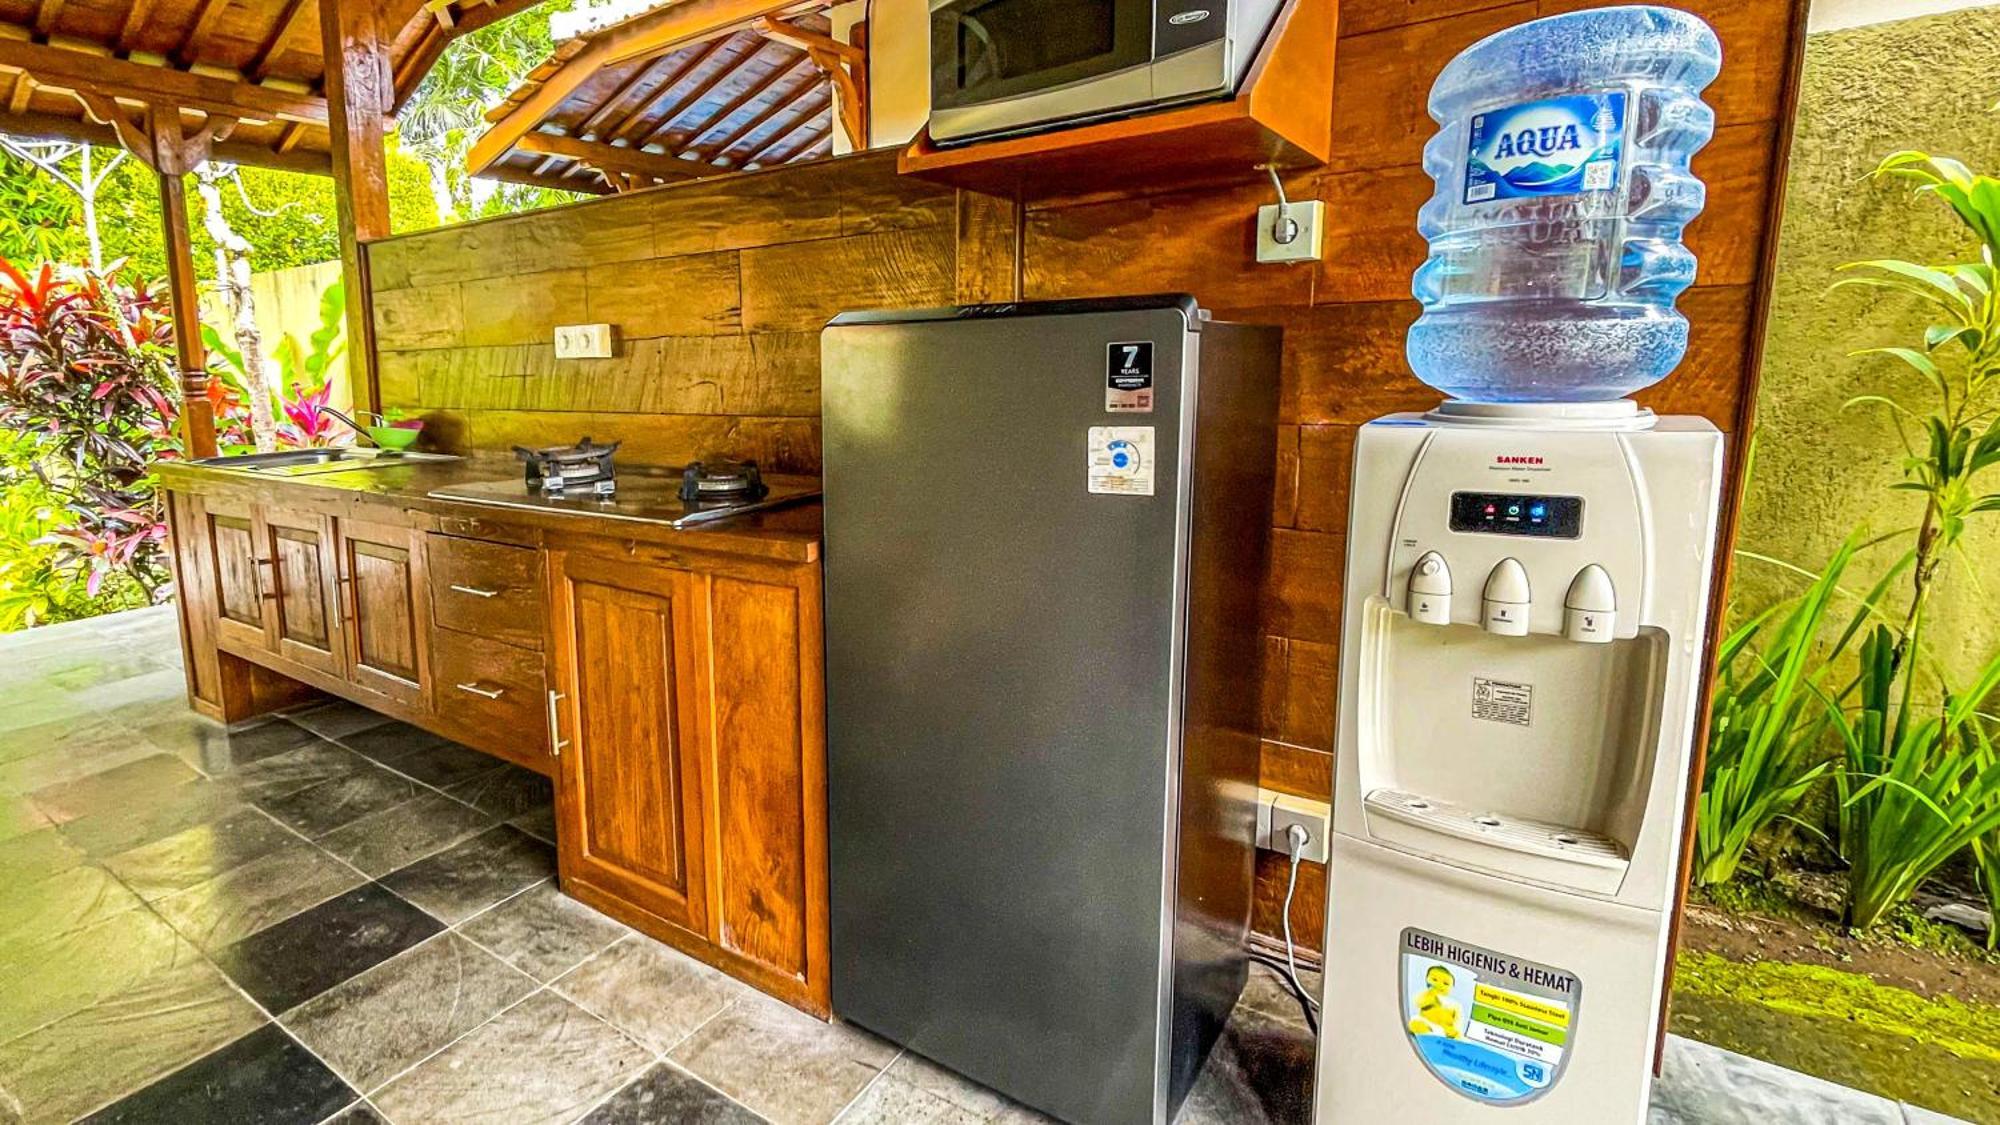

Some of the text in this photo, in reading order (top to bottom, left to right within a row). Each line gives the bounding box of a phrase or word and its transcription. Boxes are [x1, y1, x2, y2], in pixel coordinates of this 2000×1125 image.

[1494, 124, 1581, 160] AQUA
[1122, 345, 1139, 368] 7
[1496, 455, 1543, 464] SANKEN
[1407, 932, 1574, 993] LEBIH HIGIENIS & HEMAT
